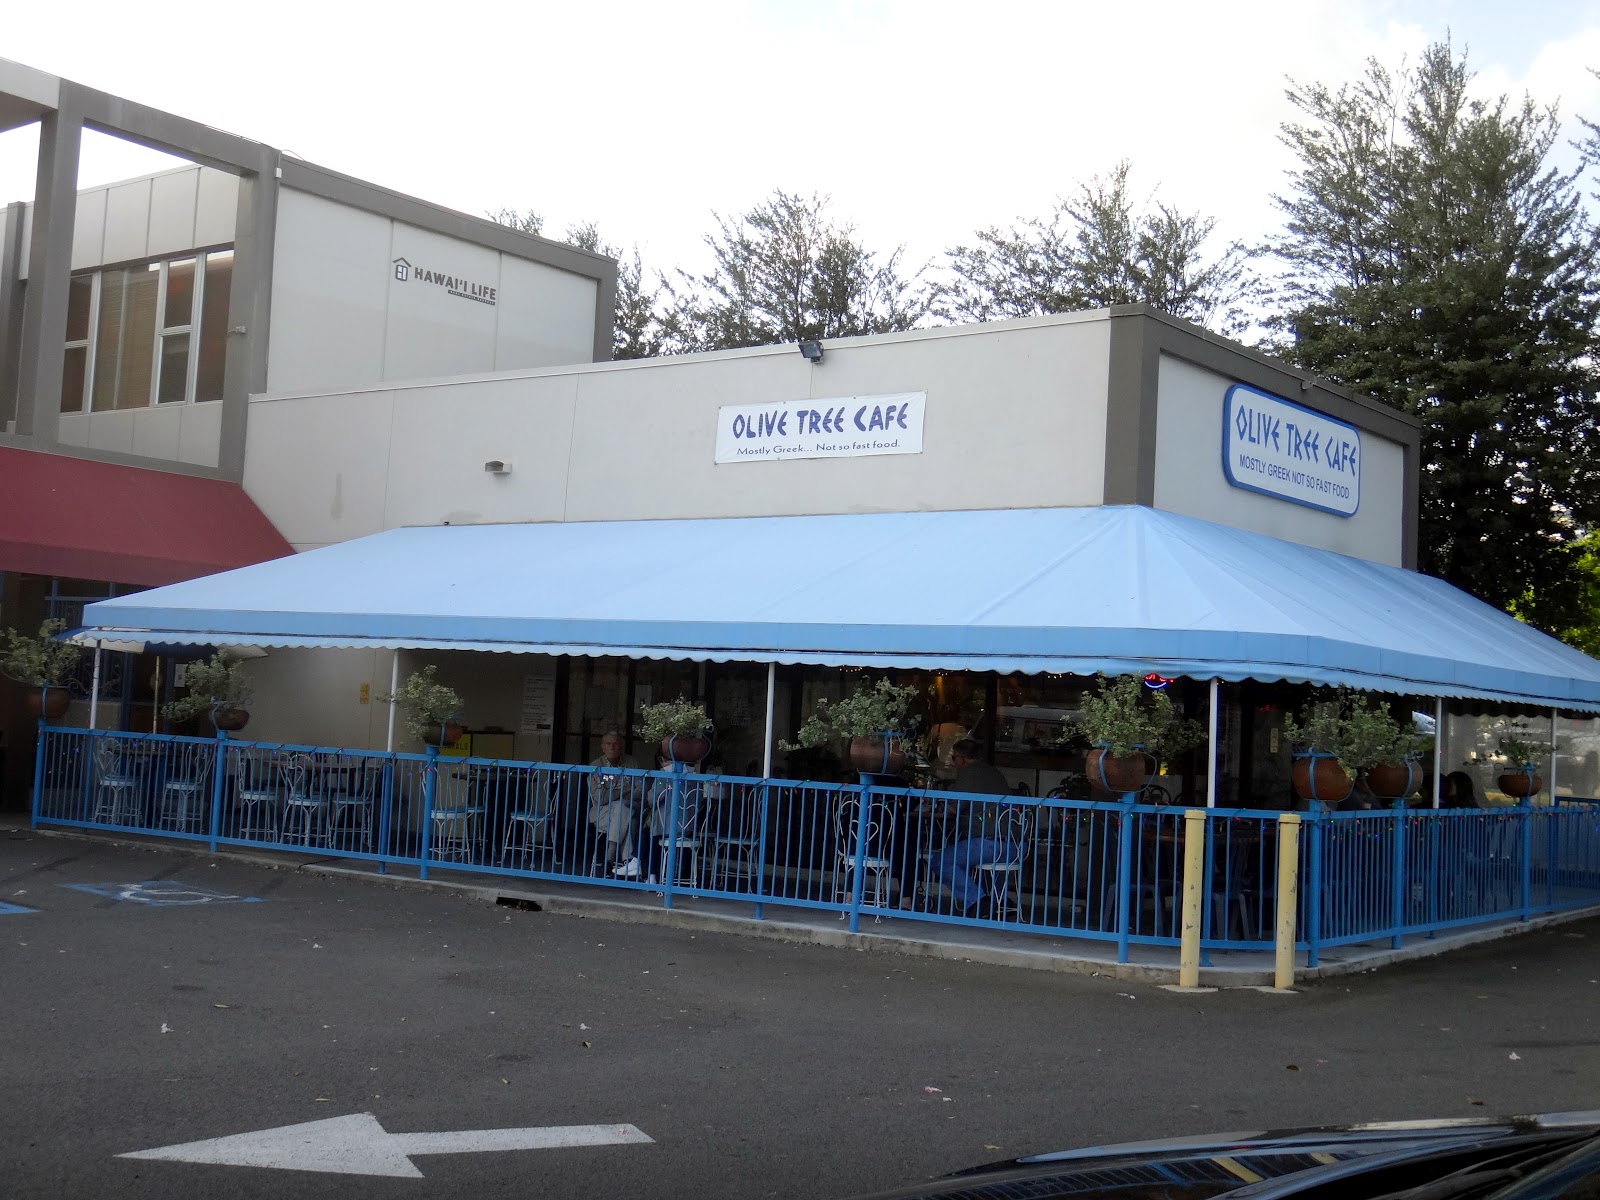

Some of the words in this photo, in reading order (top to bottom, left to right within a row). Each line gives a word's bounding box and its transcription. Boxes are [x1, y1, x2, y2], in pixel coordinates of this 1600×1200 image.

[471, 283, 496, 300] LIFE
[732, 410, 788, 439] OLIVE
[796, 406, 846, 435] TREE
[853, 402, 909, 432] CAFE
[736, 446, 770, 455] Mostly
[816, 443, 837, 452] Not
[852, 441, 871, 450] fast
[872, 439, 901, 448] food.
[1235, 404, 1280, 453] OLIVE
[1286, 422, 1320, 464] TREE
[1325, 436, 1357, 477] CAFE
[1239, 454, 1266, 474] MOSTLY
[1267, 463, 1291, 482] GREEK
[1291, 471, 1305, 486] NOT
[1306, 474, 1315, 490] SO
[1315, 478, 1333, 494] FAST
[1332, 483, 1350, 499] FOOD
